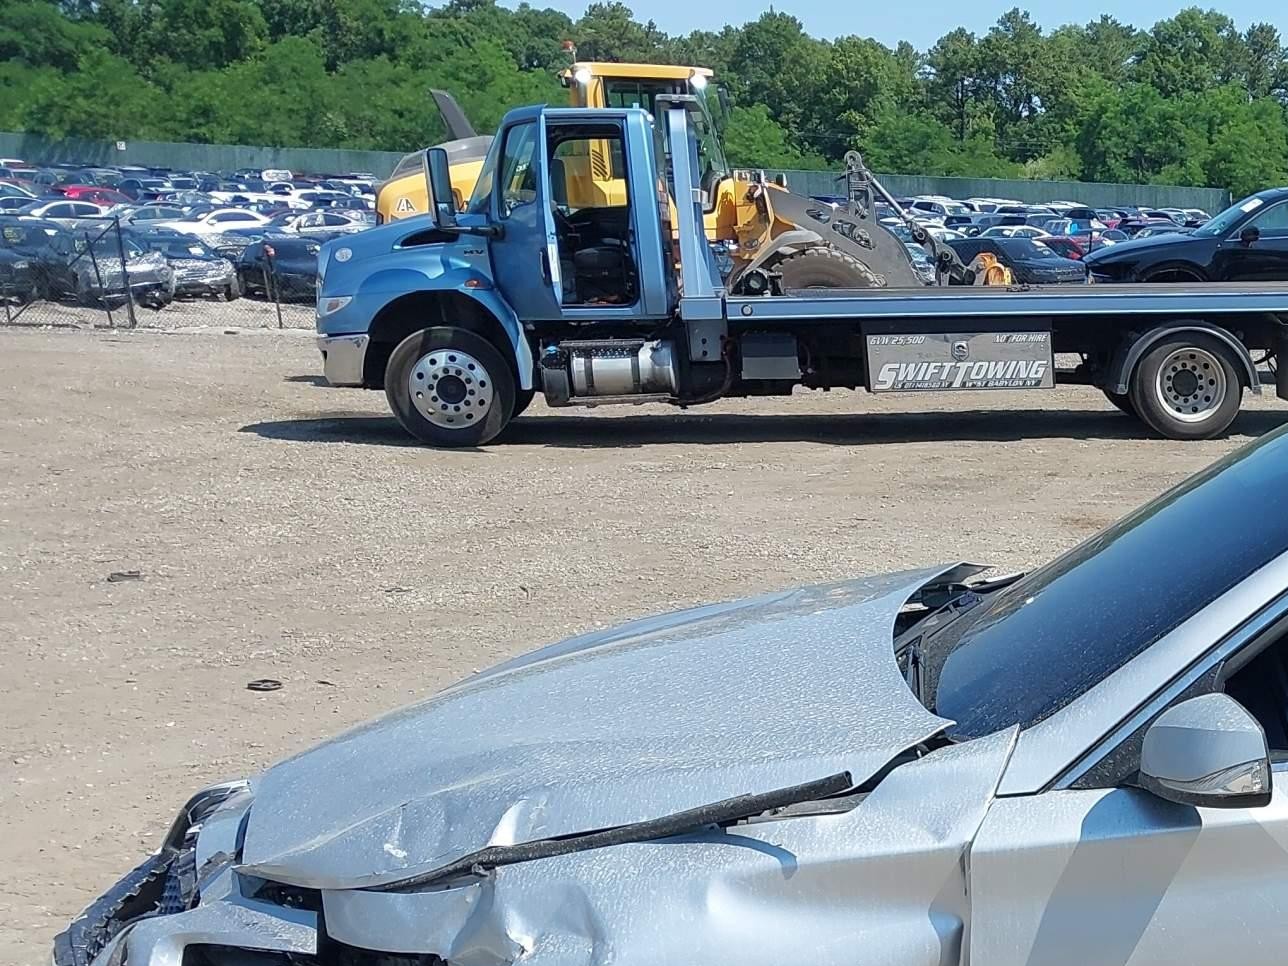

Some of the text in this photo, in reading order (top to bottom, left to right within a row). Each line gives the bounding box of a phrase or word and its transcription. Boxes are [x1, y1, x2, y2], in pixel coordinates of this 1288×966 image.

[891, 336, 925, 346] 25,500
[1011, 334, 1028, 342] FOR
[1028, 333, 1048, 342] HIRE
[875, 360, 1049, 389] SWIFT TOWING
